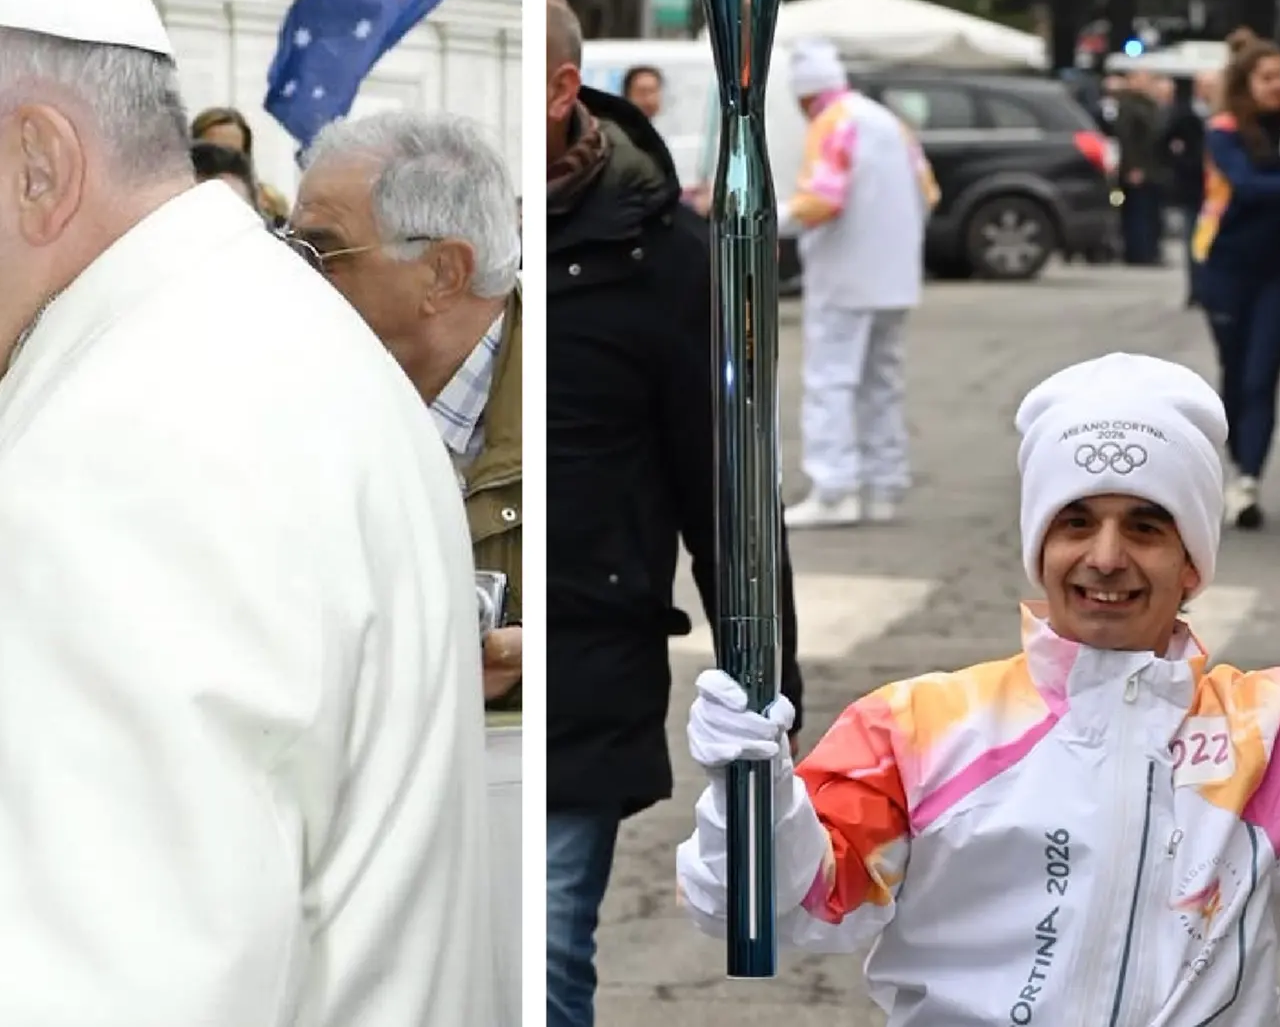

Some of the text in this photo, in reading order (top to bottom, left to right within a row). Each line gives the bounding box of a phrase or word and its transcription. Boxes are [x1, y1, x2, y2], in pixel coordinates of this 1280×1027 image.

[1058, 420, 1168, 443] MILANO CORTINA
[1096, 430, 1126, 440] 2026
[1009, 828, 1071, 1027] ORTINA 2026
